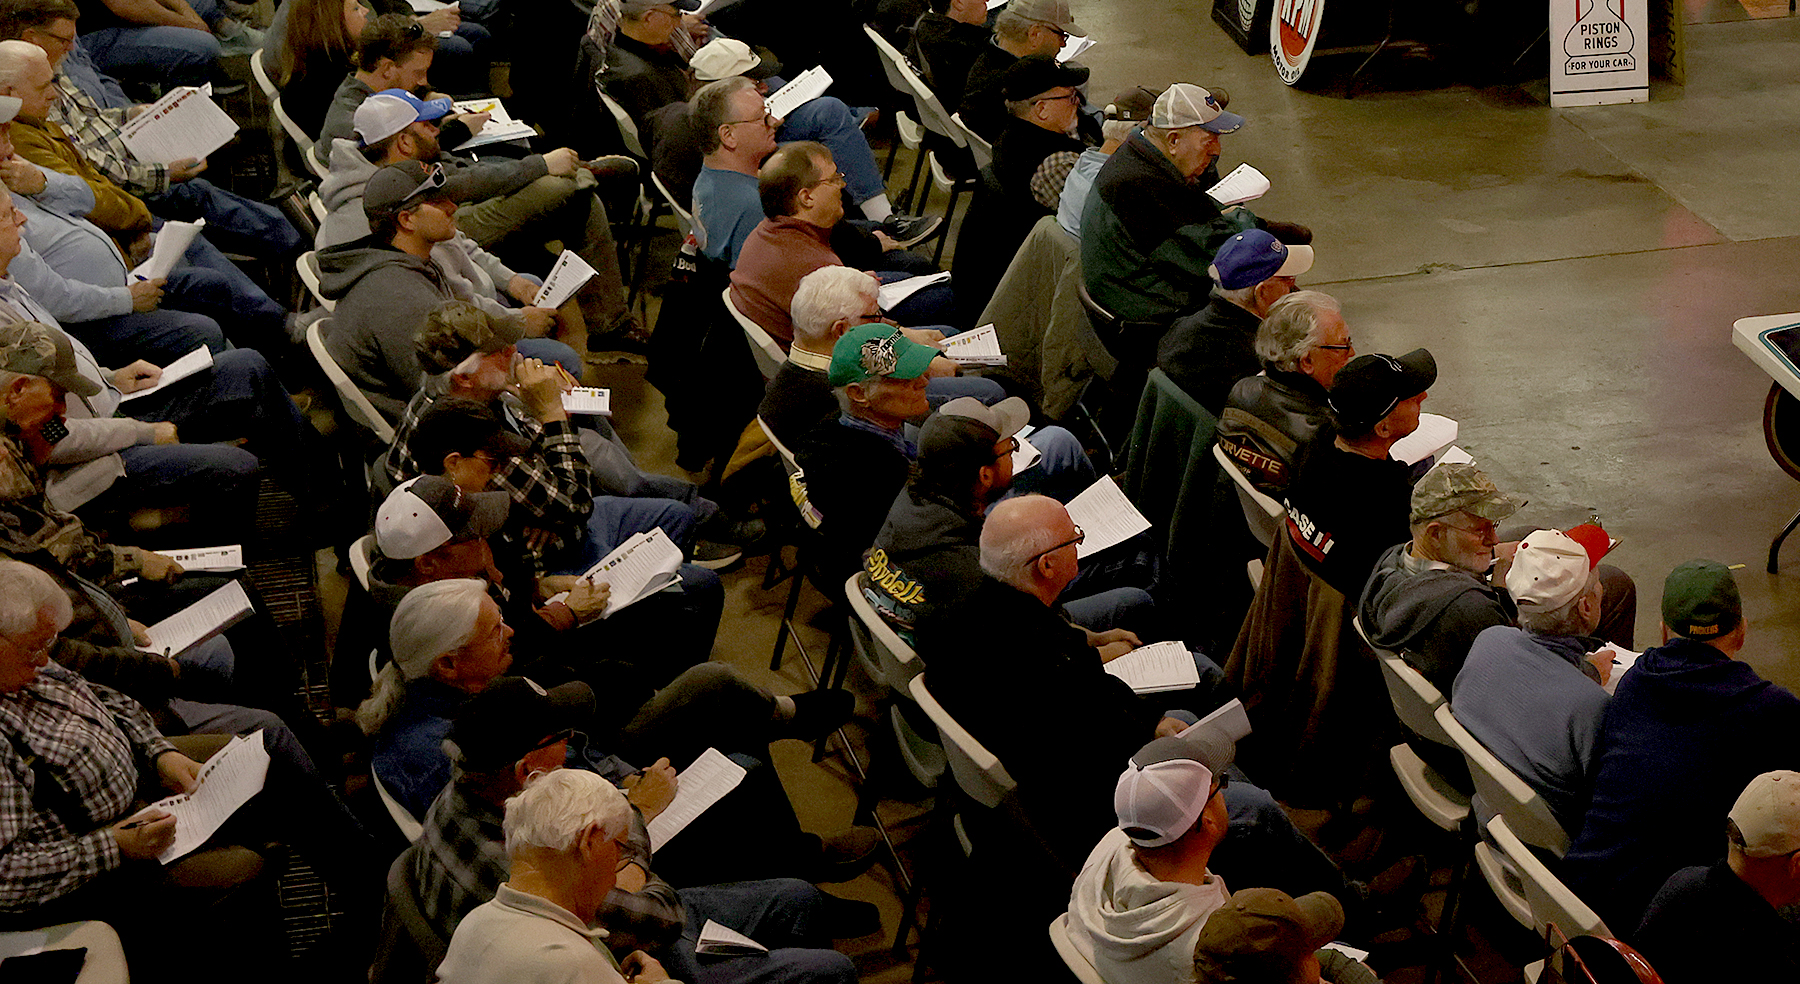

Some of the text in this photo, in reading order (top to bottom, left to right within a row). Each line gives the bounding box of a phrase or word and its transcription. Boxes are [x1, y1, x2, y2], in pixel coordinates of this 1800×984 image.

[1580, 21, 1621, 37] PISTON
[1583, 35, 1619, 50] RINGS
[1570, 58, 1630, 71] FOR YOUR CAR
[1283, 497, 1316, 544] CASE
